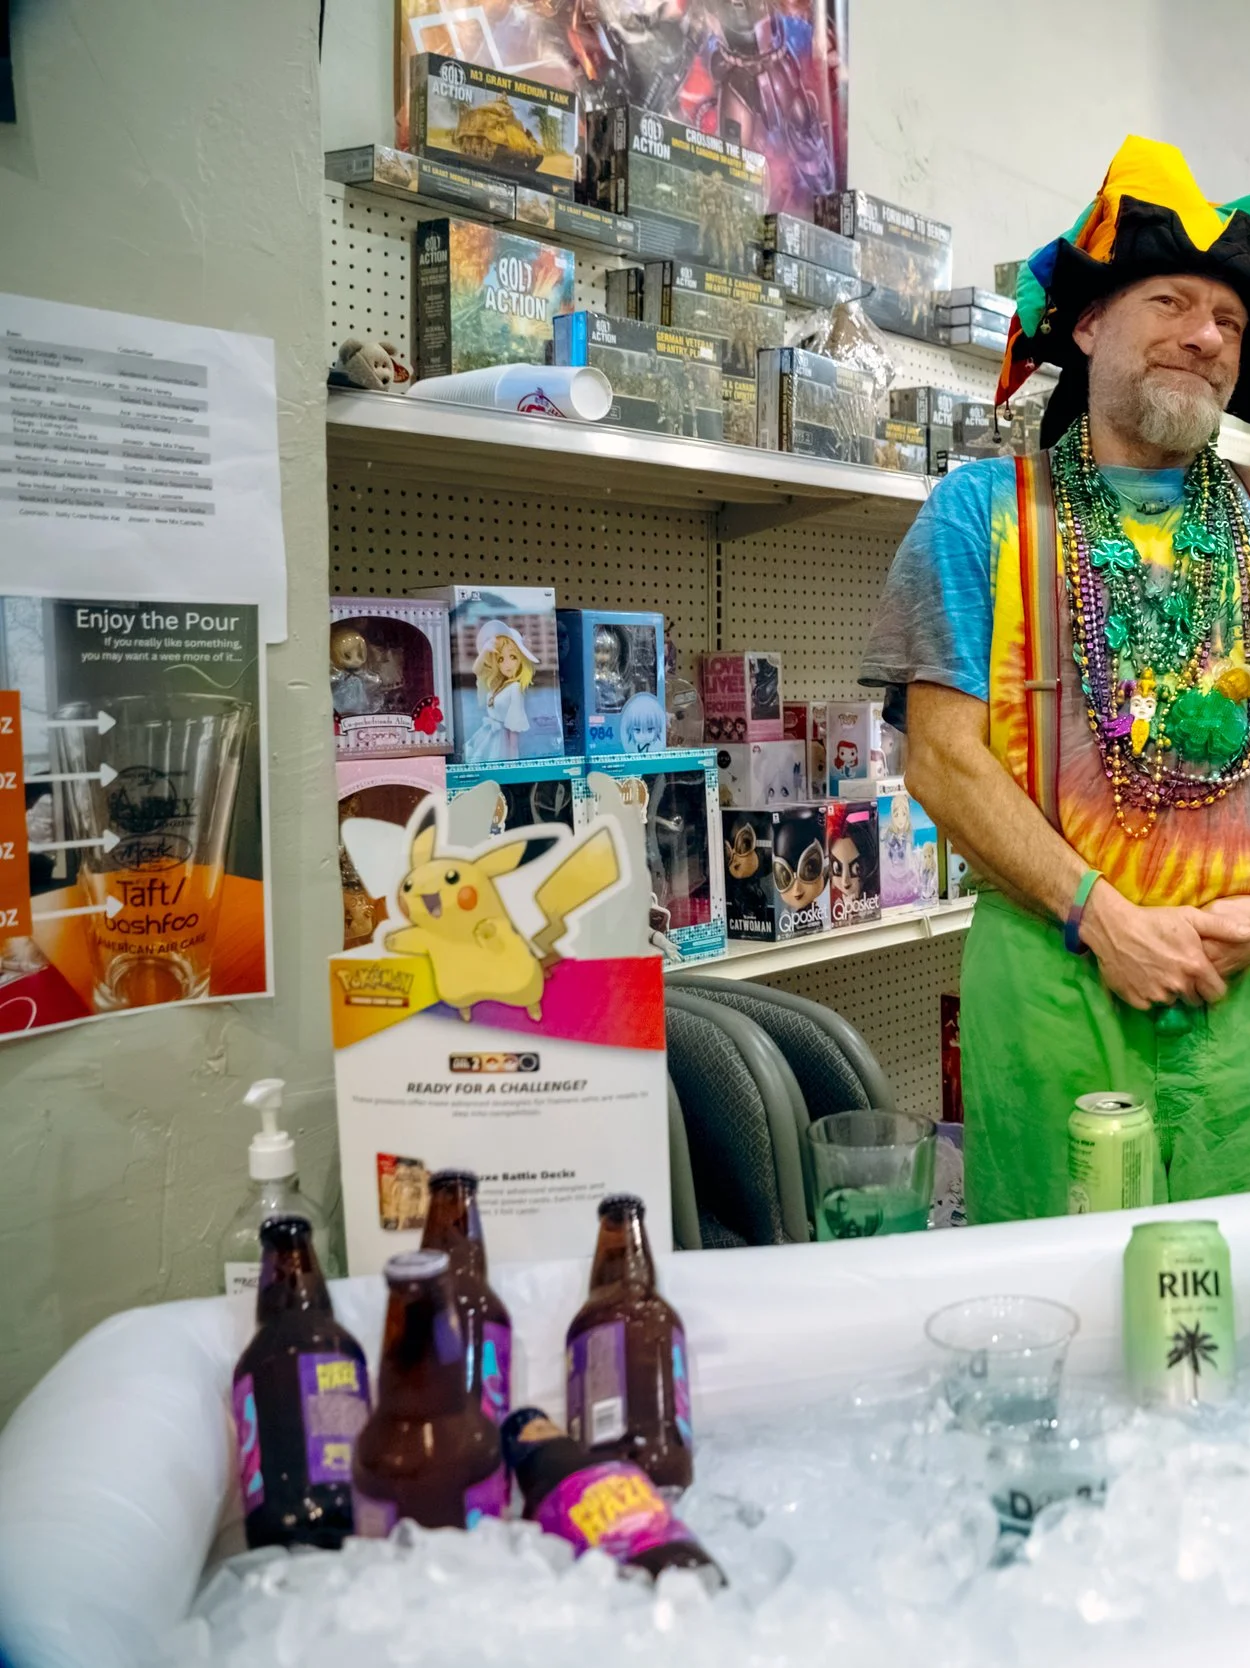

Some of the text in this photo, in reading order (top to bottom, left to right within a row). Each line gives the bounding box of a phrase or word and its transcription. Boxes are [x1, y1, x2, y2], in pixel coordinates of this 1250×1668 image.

[441, 65, 464, 86] BOLT
[432, 82, 473, 103] ACTION
[470, 69, 569, 106] M3 GRANT MEDIUM TANK
[640, 118, 663, 140] BOLT
[632, 135, 671, 161] ACTION
[685, 128, 740, 158] CROSSING THE
[424, 236, 441, 252] BOLT
[419, 250, 448, 266] ACTION
[499, 257, 533, 293] BOLT
[675, 276, 698, 290] ACTION
[485, 284, 548, 322] ACTION
[591, 331, 617, 344] ACTION
[655, 331, 714, 350] GERMAN VETERAN
[932, 410, 953, 426] ACTI
[964, 416, 990, 426] ACTION
[76, 608, 240, 635] Enjoy the Pour
[104, 637, 113, 647] If
[113, 639, 133, 650] you
[134, 637, 163, 650] really
[164, 637, 183, 649] like
[81, 654, 101, 664] you
[102, 654, 124, 663] may
[125, 652, 150, 662] want
[150, 654, 158, 662] a
[159, 654, 182, 662] wee
[183, 654, 210, 663] more
[211, 652, 225, 662] of
[589, 725, 615, 742] 984
[832, 892, 880, 922] Qposket
[728, 918, 772, 933] CATWOMAN
[96, 933, 207, 955] AMERICAN AIR CARE
[407, 1079, 588, 1094] READY FOR A CHALLENGE?
[501, 1169, 576, 1181] Battle Decks
[1158, 1269, 1220, 1299] RIKI
